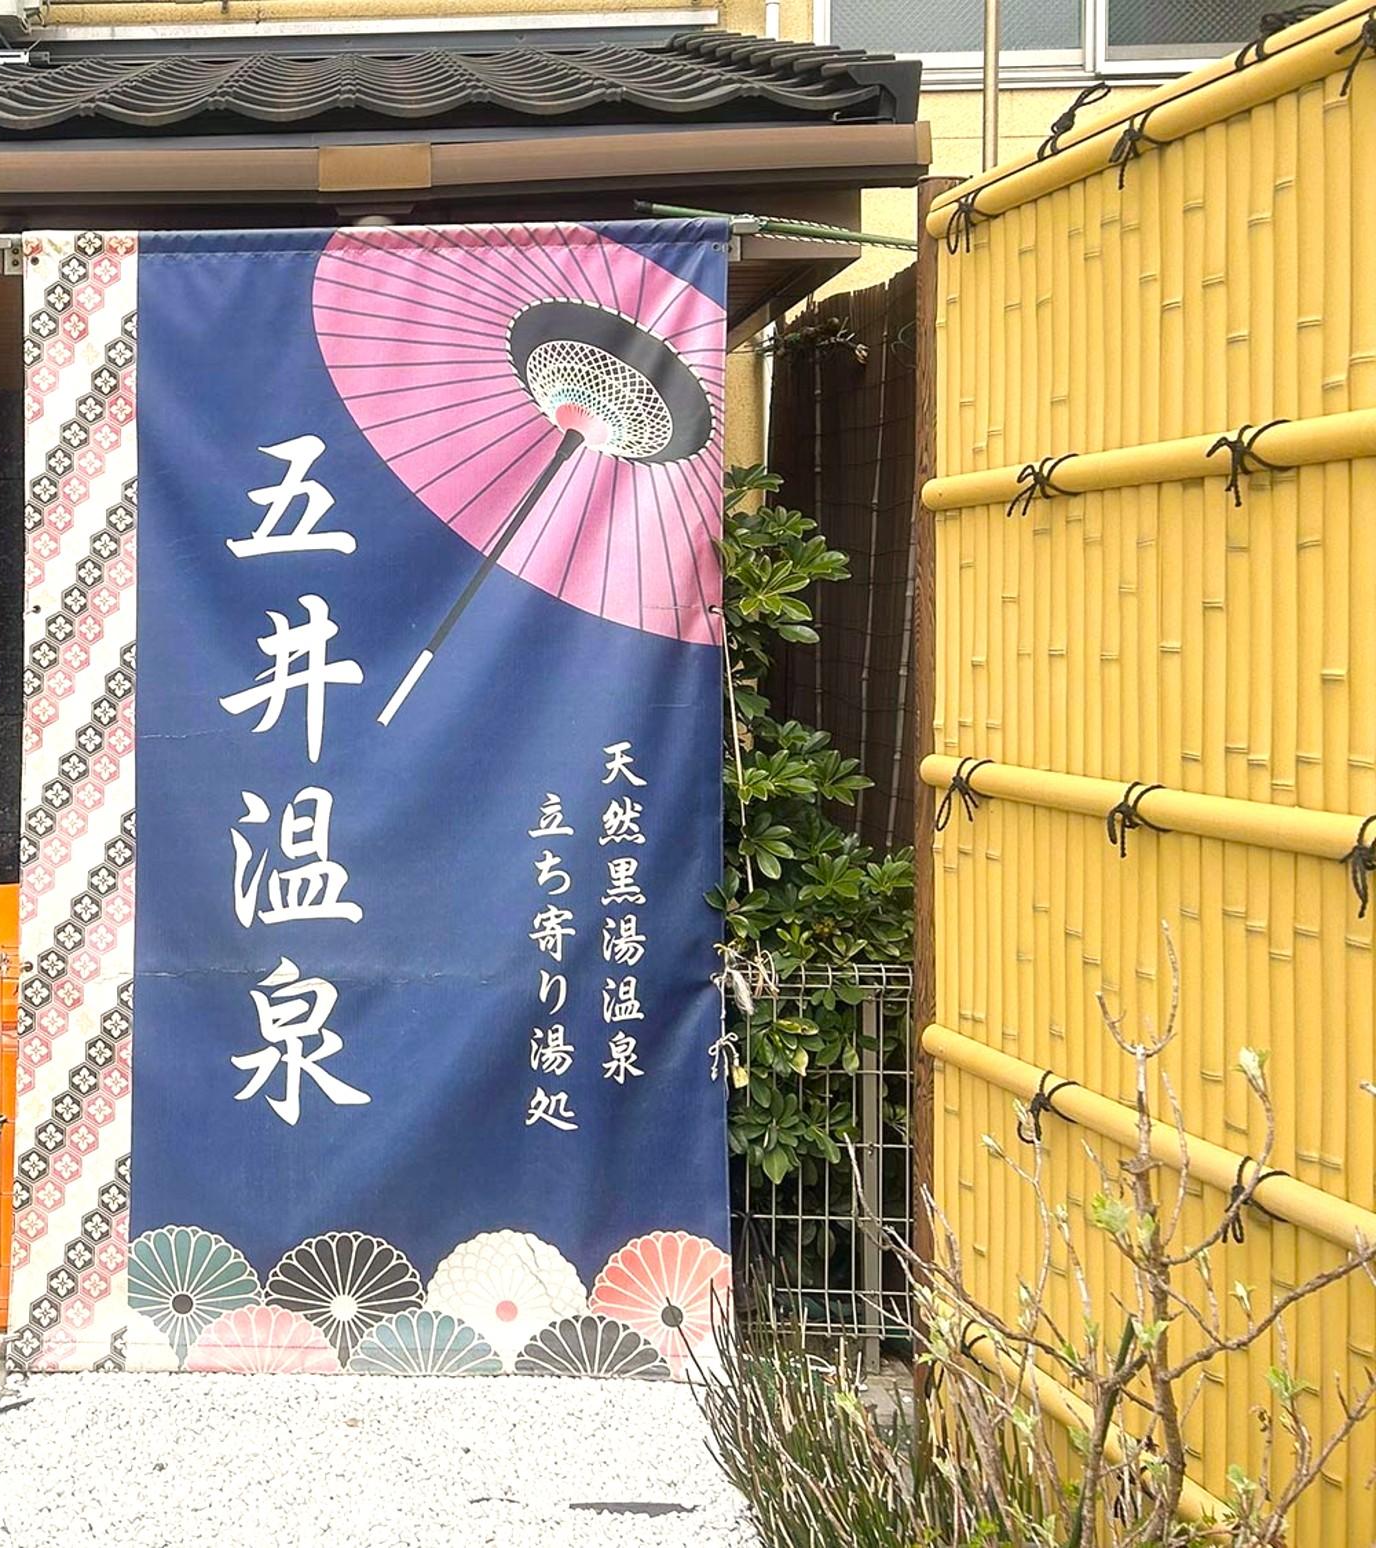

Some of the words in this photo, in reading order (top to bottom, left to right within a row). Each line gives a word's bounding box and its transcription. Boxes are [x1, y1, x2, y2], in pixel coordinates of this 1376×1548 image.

[219, 432, 373, 1126] 五井温泉
[599, 740, 649, 1085] 天然黒湯温泉
[525, 792, 580, 1132] 立ち寄り湯処
